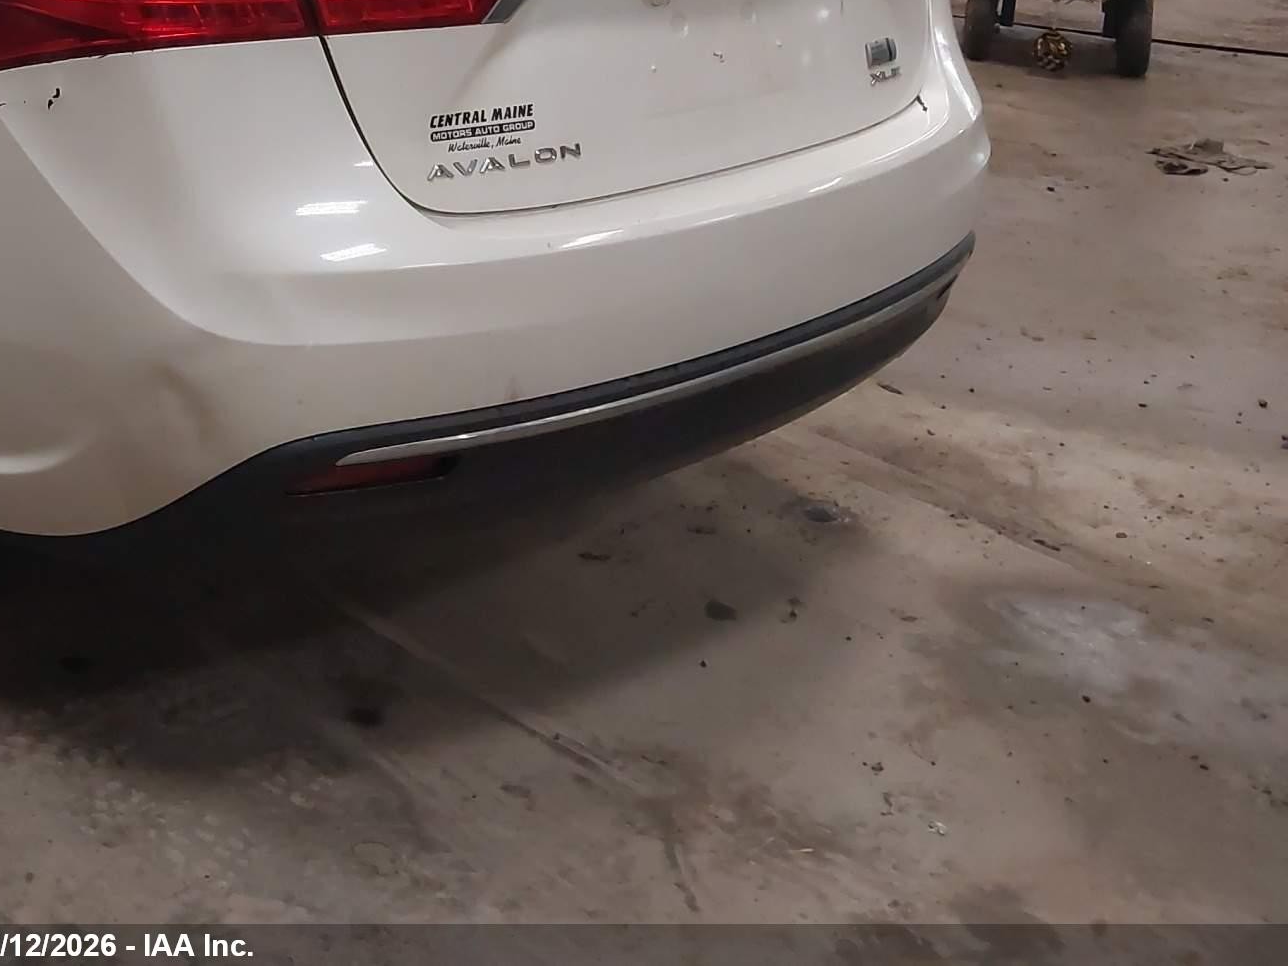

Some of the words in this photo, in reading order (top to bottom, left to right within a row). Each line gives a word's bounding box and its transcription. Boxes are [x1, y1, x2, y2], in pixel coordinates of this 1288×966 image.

[430, 109, 487, 129] CENTRAL
[491, 104, 534, 122] MAINE
[432, 129, 473, 141] MOTORS
[475, 126, 500, 136] AUTO
[503, 121, 534, 132] GROUP
[427, 143, 582, 182] AVALON
